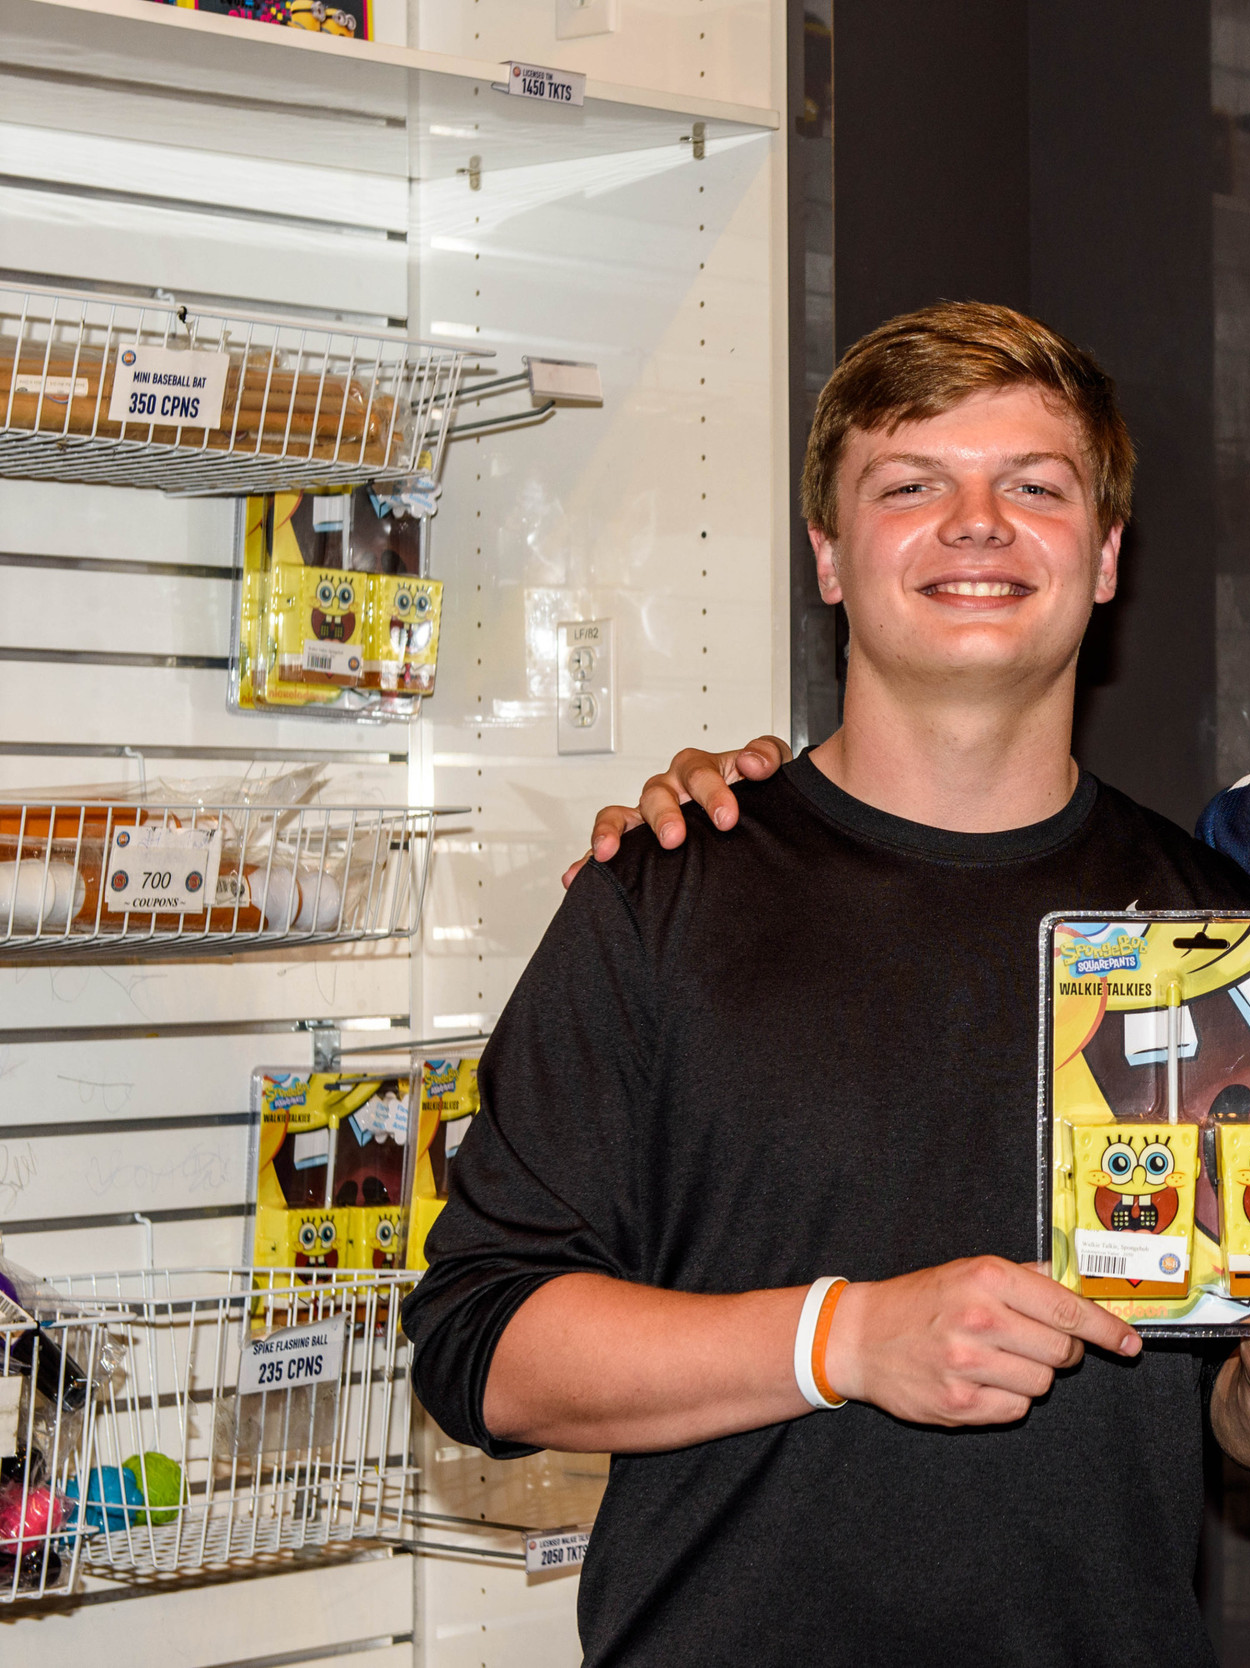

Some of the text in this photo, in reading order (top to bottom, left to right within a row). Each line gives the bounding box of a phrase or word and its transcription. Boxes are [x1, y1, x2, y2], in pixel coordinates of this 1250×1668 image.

[522, 78, 572, 101] 1450 TKTS
[133, 371, 207, 389] MINI BASEBALL BAT
[129, 392, 201, 418] 350 CPNS
[141, 871, 172, 889] 700
[132, 897, 179, 908] COUPONS
[1060, 935, 1149, 966] SpongeBob
[1077, 957, 1136, 973] SQUAREPANTS
[1060, 982, 1152, 997] WALKIE TALKIES
[422, 1101, 460, 1111] WALKIE TALKIES
[263, 1113, 311, 1124] WALKIE TALKIES
[253, 1334, 328, 1356] SPIKE FLASHING BALL
[258, 1355, 323, 1385] 235 CPNS
[541, 1548, 564, 1566] 2050
